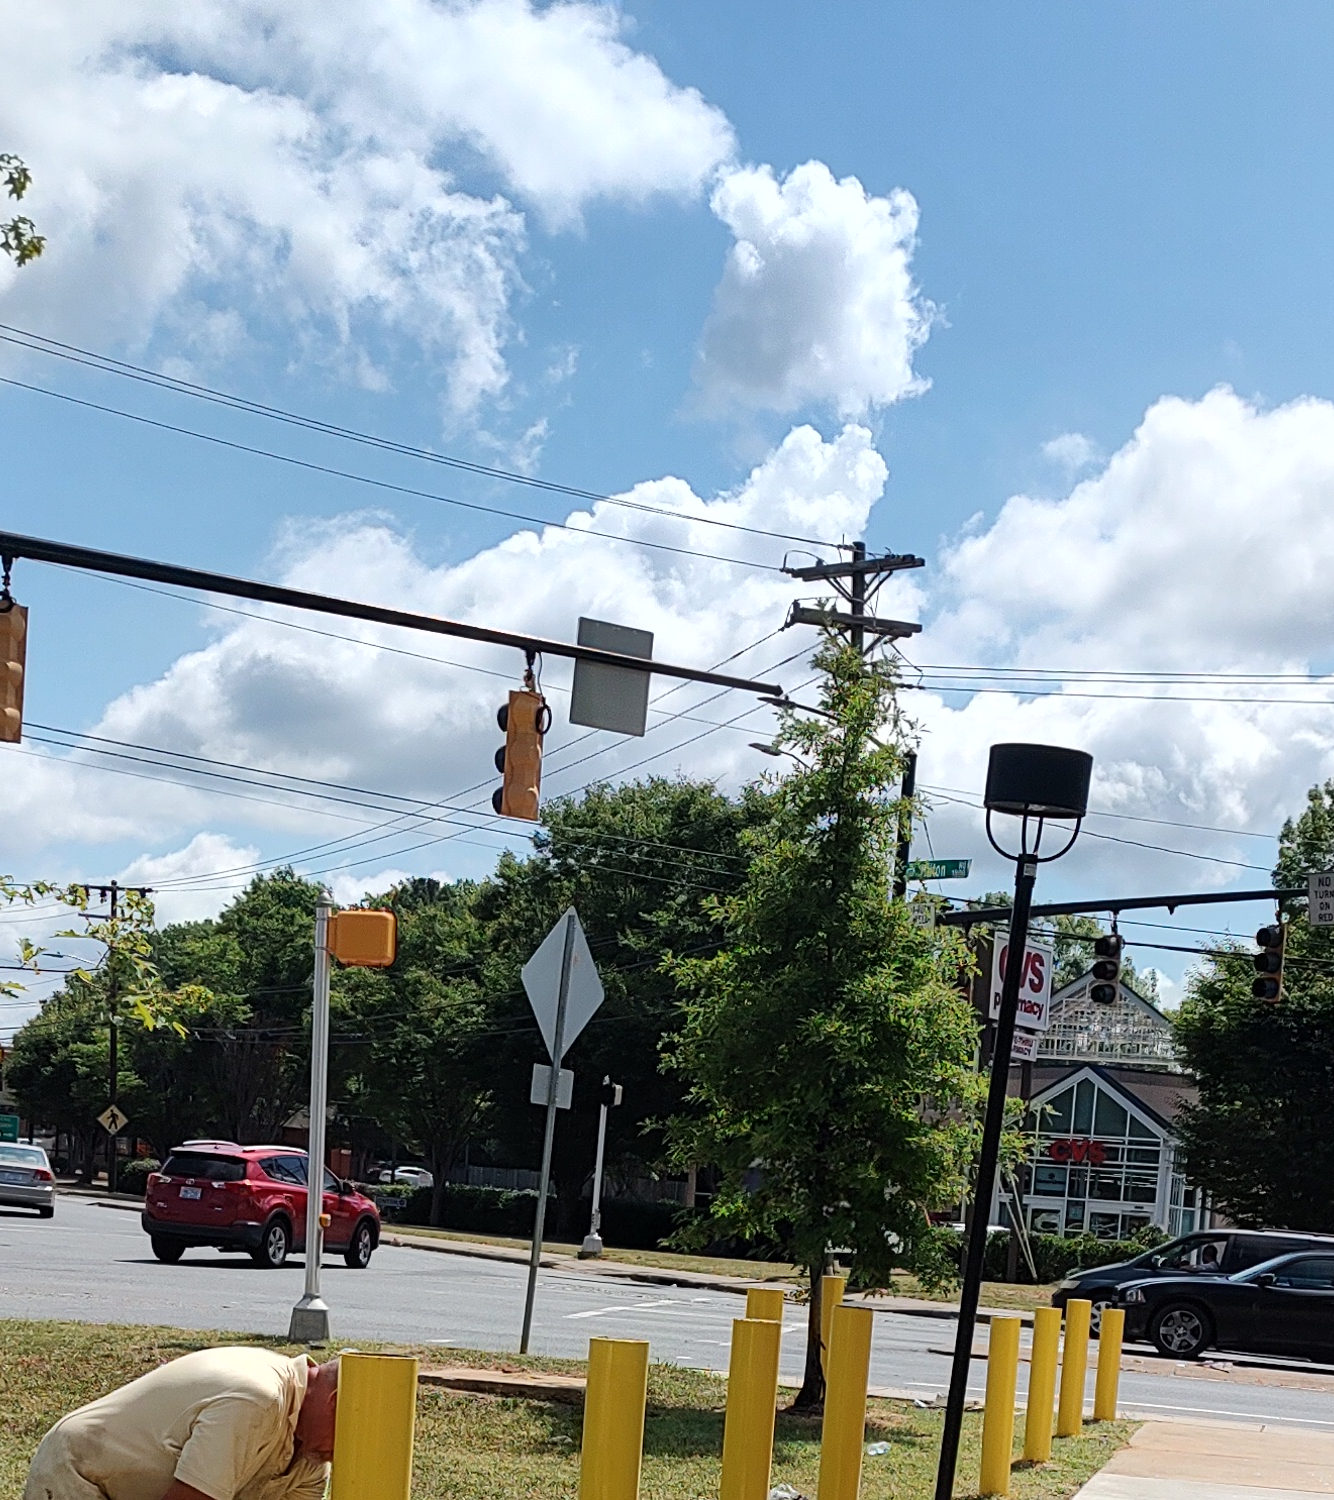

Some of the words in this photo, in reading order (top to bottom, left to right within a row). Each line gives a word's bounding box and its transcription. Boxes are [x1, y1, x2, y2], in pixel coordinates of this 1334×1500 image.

[1318, 876, 1331, 887] NO
[1314, 890, 1334, 899] TURN
[1319, 902, 1330, 910] ON
[1318, 913, 1334, 922] RED
[993, 992, 1044, 1021] pmacy
[1049, 1140, 1107, 1165] CVS
